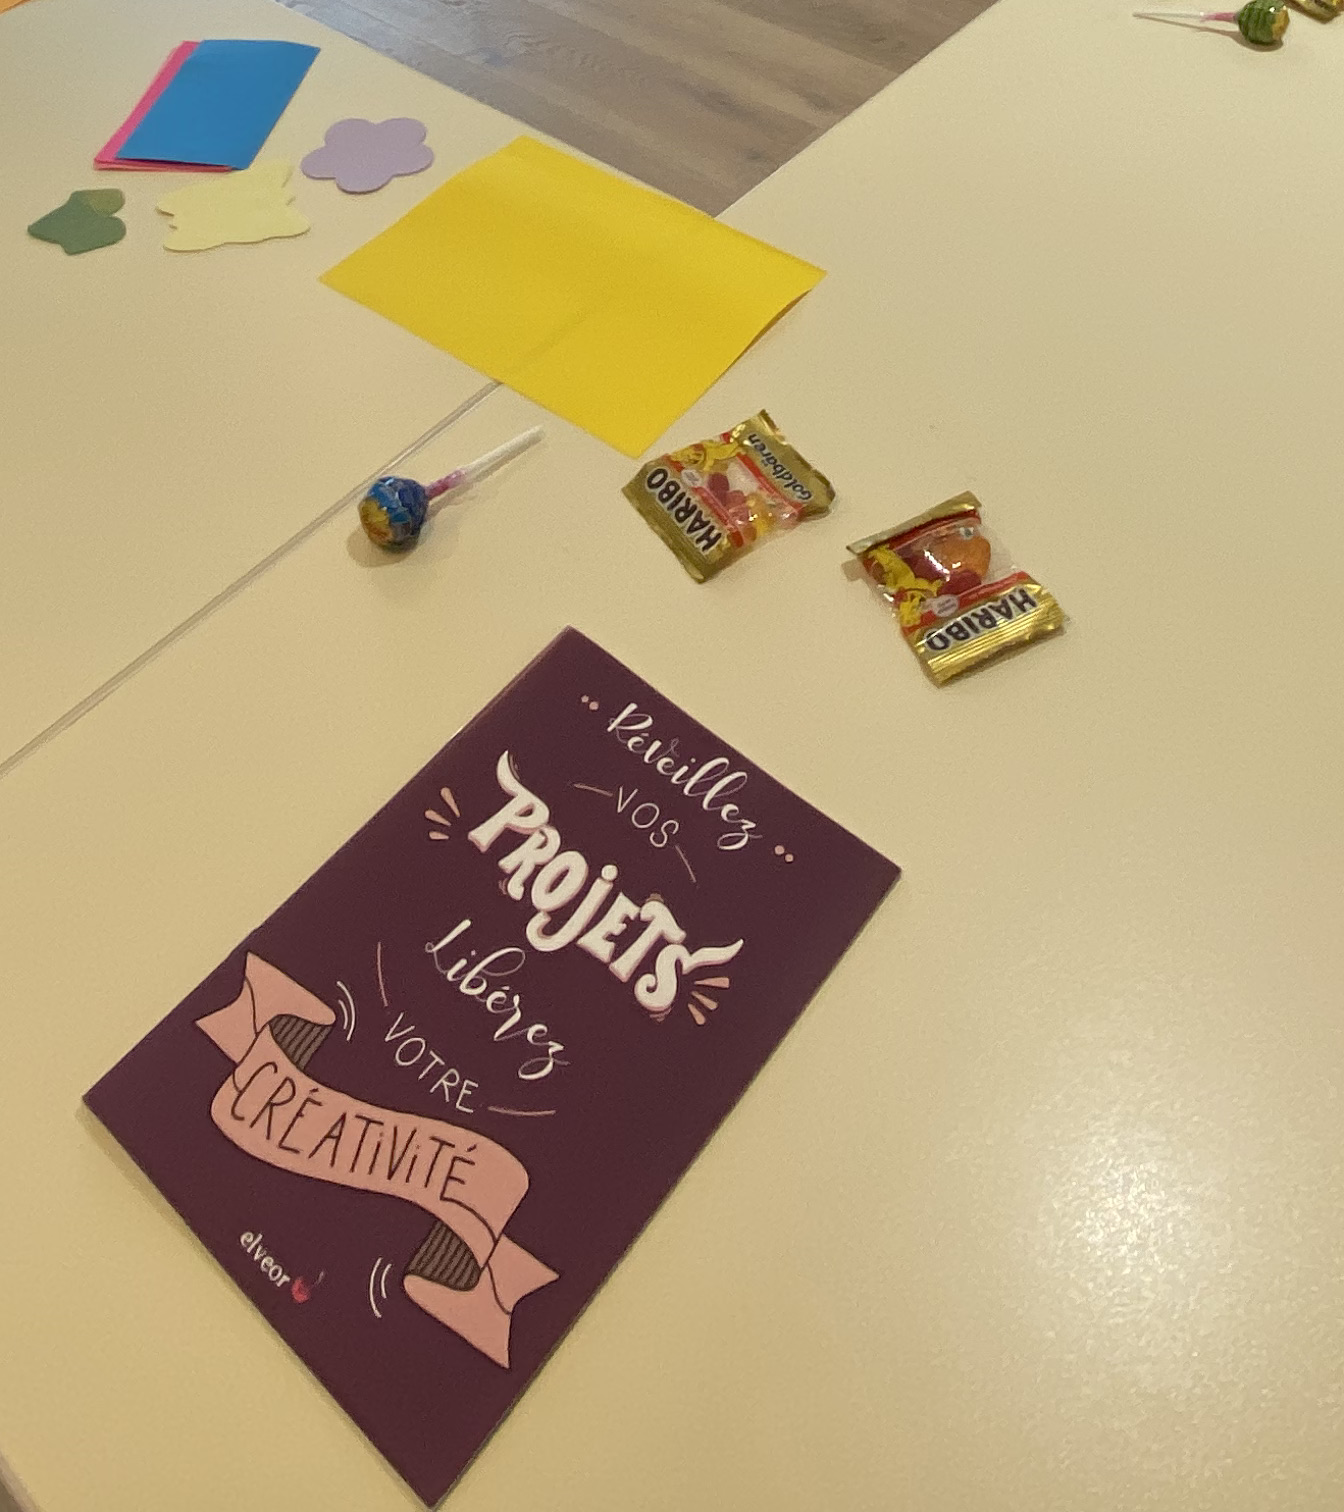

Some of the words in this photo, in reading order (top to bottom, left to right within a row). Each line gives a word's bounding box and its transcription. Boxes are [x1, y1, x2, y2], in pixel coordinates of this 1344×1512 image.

[748, 433, 812, 500] Goldbären
[646, 467, 723, 554] HARIBO
[925, 587, 1038, 653] HARIBO
[608, 702, 762, 851] Réveillez
[616, 786, 679, 850] VOS
[425, 919, 569, 1081] Libérez
[384, 1012, 478, 1115] VOTRE
[238, 1229, 293, 1292] elveor
